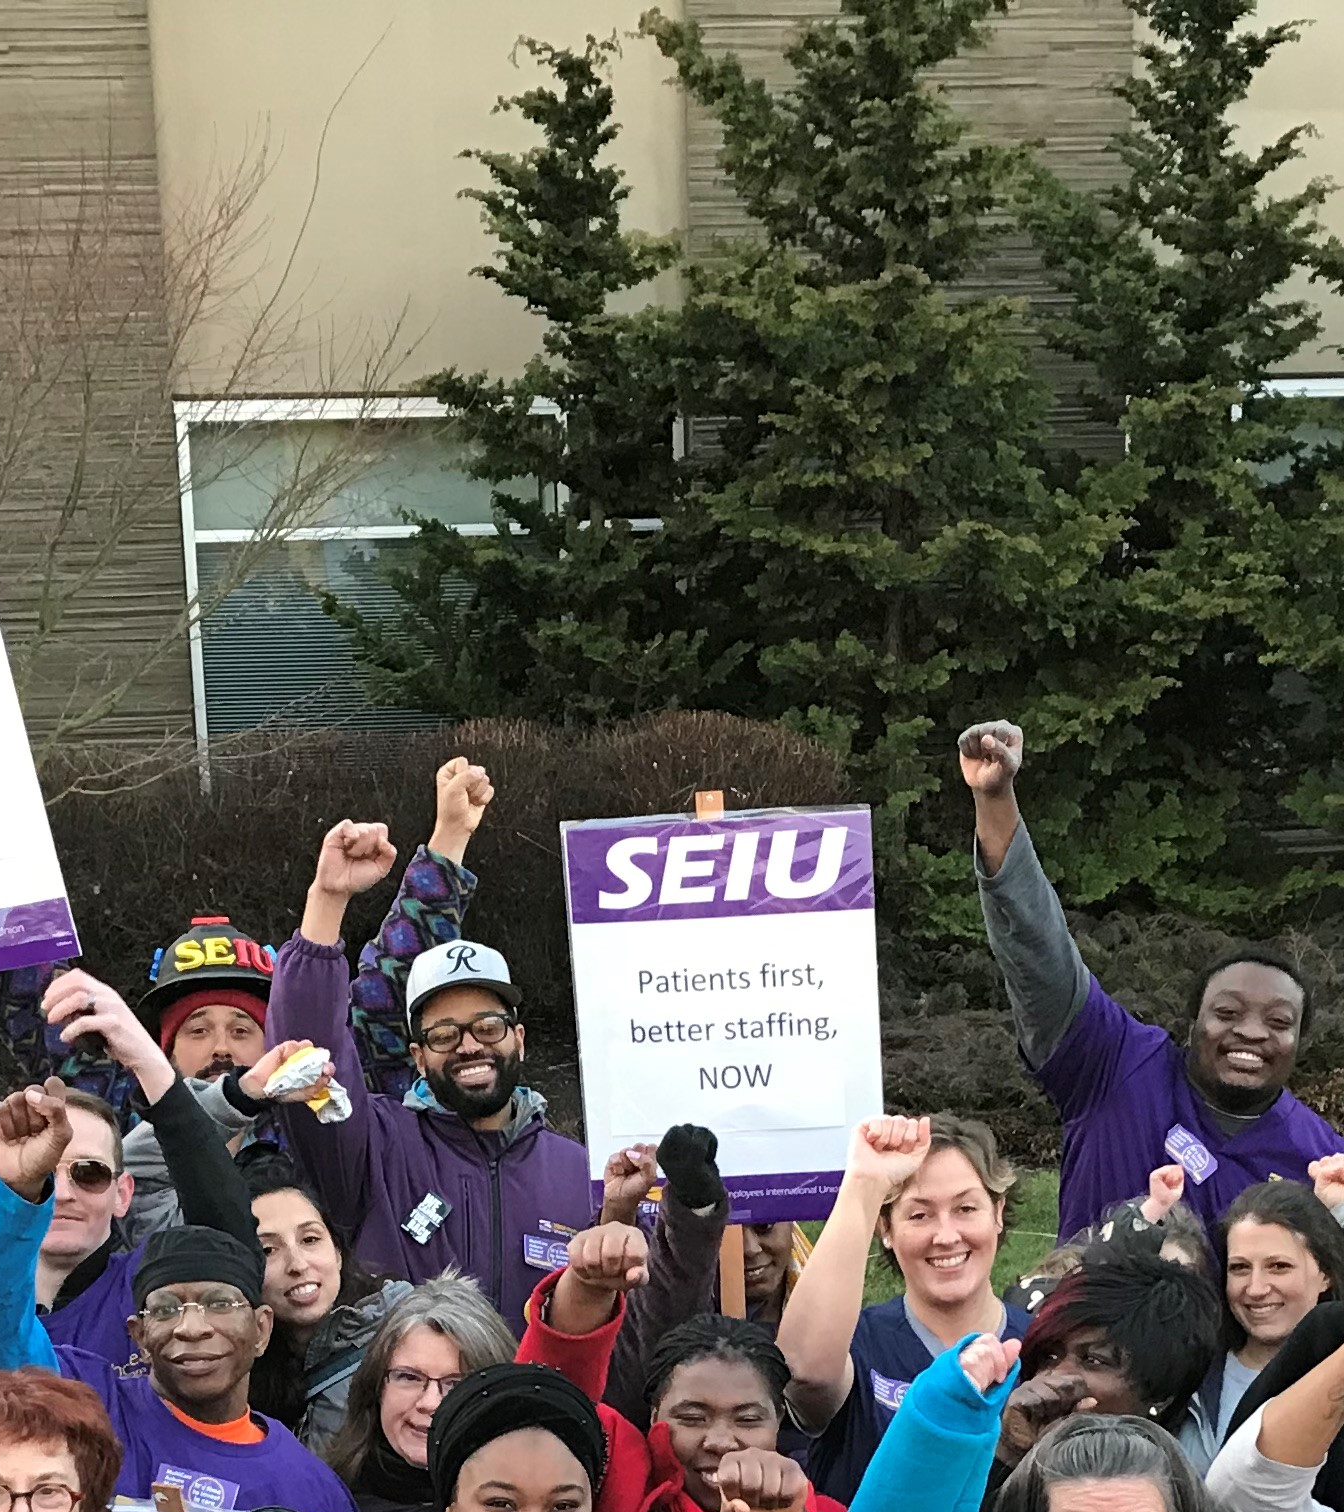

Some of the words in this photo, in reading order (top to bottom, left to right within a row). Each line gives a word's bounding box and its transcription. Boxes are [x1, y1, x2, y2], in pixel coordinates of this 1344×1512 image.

[598, 826, 849, 911] SEIU
[174, 937, 275, 974] SEIU
[446, 945, 481, 975] R
[638, 967, 751, 994] Patients
[759, 963, 825, 991] first,
[630, 1018, 715, 1044] better
[723, 1013, 838, 1042] staffing,
[698, 1062, 773, 1090] NOW
